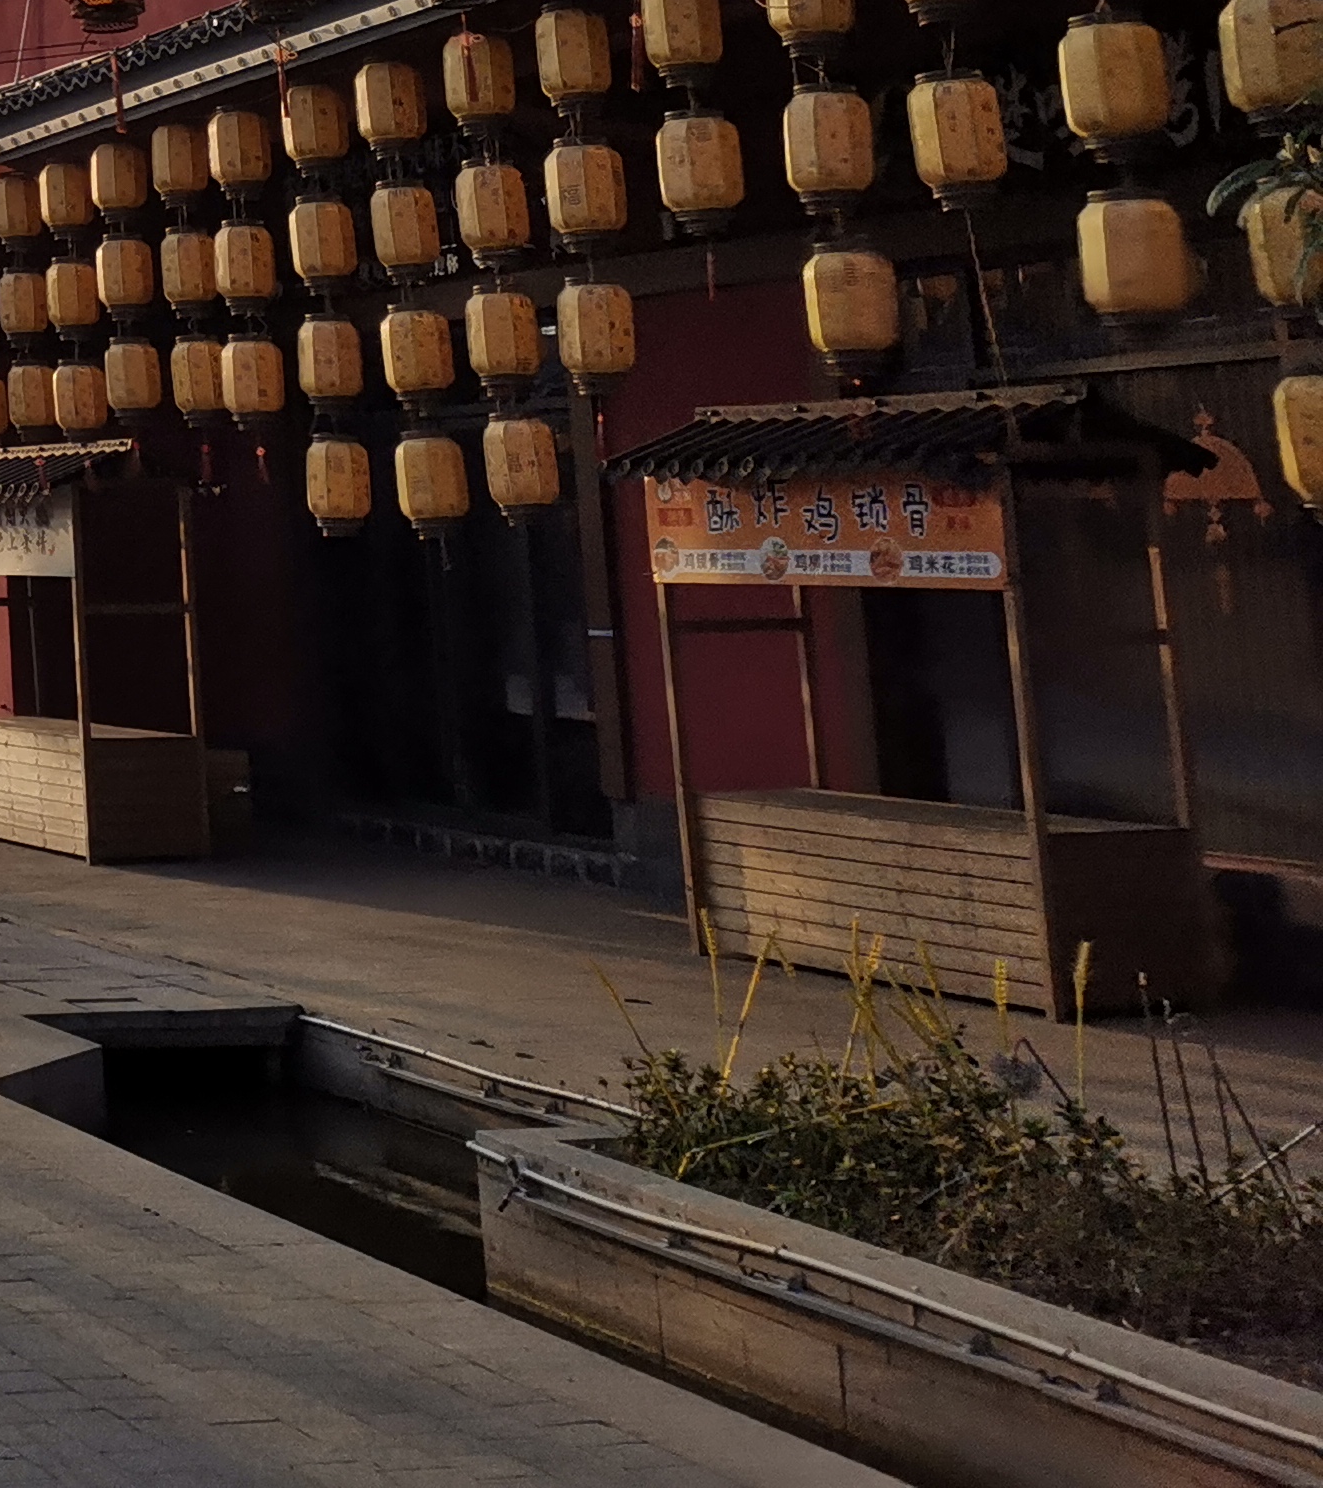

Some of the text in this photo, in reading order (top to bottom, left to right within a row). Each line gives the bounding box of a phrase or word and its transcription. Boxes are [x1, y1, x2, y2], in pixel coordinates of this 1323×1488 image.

[706, 479, 931, 544] 酥炸鸡锁骨
